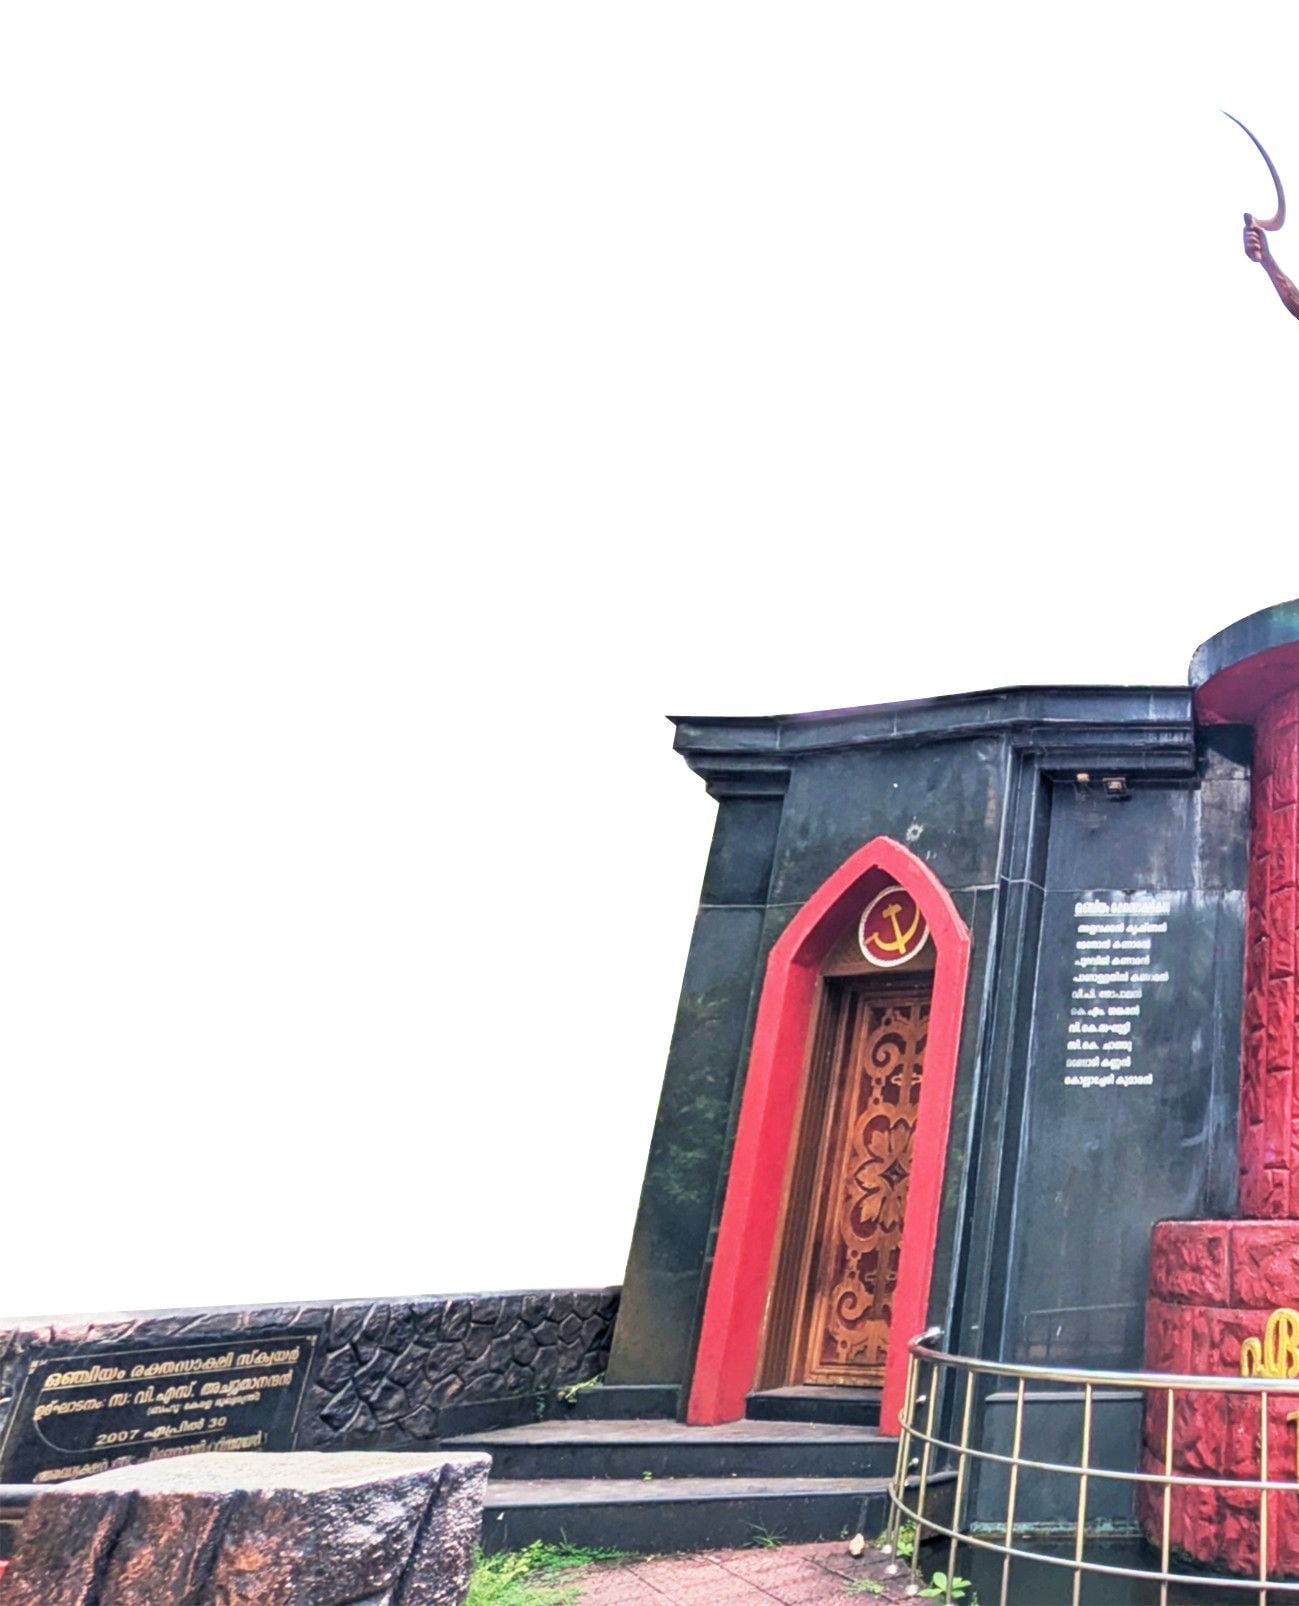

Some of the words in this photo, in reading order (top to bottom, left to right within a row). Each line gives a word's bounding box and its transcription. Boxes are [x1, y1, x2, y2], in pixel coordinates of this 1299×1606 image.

[44, 1365, 126, 1388] ഒഞ്ചിയം
[95, 1429, 140, 1446] 2007
[208, 1416, 228, 1430] 30
